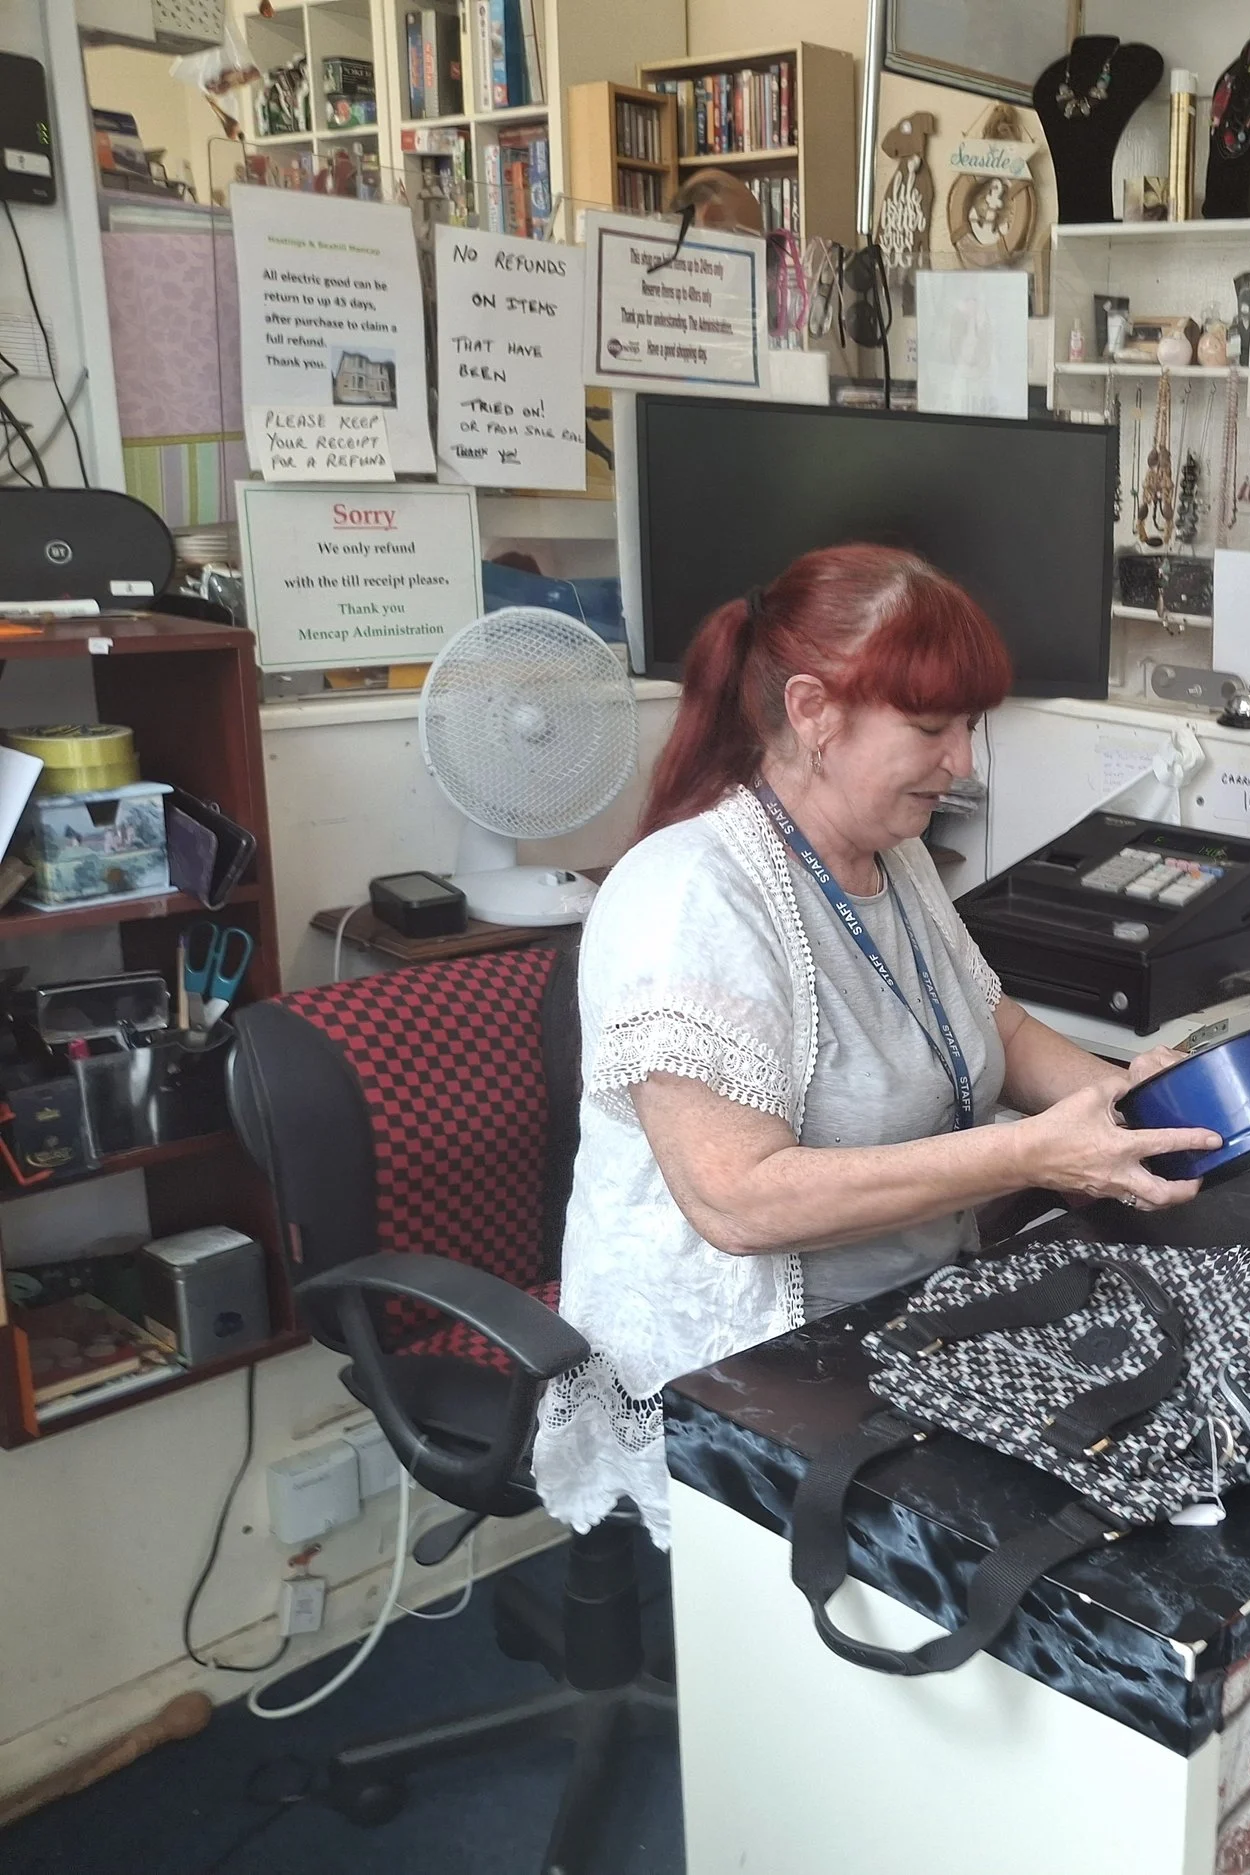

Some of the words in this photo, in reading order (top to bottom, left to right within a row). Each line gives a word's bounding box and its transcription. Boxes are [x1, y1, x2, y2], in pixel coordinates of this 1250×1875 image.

[951, 142, 1010, 169] Seaside
[453, 244, 478, 263] NO
[495, 250, 567, 277] REFUNDS
[263, 267, 277, 280] All
[281, 271, 320, 286] electric
[324, 277, 350, 289] good
[354, 280, 371, 290] can
[374, 279, 388, 292] be
[642, 279, 660, 297] Reserve
[264, 291, 300, 304] return
[303, 294, 314, 305] to
[318, 297, 331, 308] up
[472, 292, 496, 308] ON
[506, 296, 558, 316] ITEMS
[265, 312, 291, 325] after
[294, 315, 344, 328] purchase
[347, 319, 358, 330] to
[361, 321, 389, 333] claim
[391, 324, 398, 333] a
[621, 307, 636, 324] Thank
[636, 313, 645, 328] you
[688, 315, 697, 331] The
[266, 332, 284, 344] full
[287, 335, 327, 348] refund.
[452, 336, 494, 353] THAT
[508, 342, 543, 358] HAVE
[647, 340, 659, 356] Have
[266, 354, 300, 368] Thank
[459, 363, 507, 383] BEEN
[460, 397, 514, 416] TRIED
[266, 410, 326, 429] PLEASE
[340, 414, 379, 430] KEEP
[460, 420, 480, 433] OR
[487, 421, 519, 435] FROM
[267, 432, 308, 452] YOUR
[316, 435, 380, 450] RECEIPT
[271, 454, 297, 471] FOR
[307, 456, 316, 469] A
[326, 452, 386, 468] REFUND
[333, 503, 397, 531] Sorry
[317, 542, 339, 555] We
[342, 541, 370, 557] only
[374, 541, 416, 554] refund
[284, 576, 314, 589] with
[318, 575, 338, 588] the
[342, 574, 360, 587] till
[364, 574, 405, 588] receipt
[337, 603, 379, 616] Thank
[382, 604, 405, 617] you
[299, 628, 349, 641] Mencap
[353, 622, 444, 639] Administration
[766, 802, 795, 835] STAFF
[801, 850, 830, 883] STAFF
[835, 902, 862, 936] STAFF
[869, 954, 894, 986] STAFF
[922, 971, 940, 1005] STAFF
[942, 1024, 961, 1058] STAFF
[959, 1076, 971, 1112] STAFF
